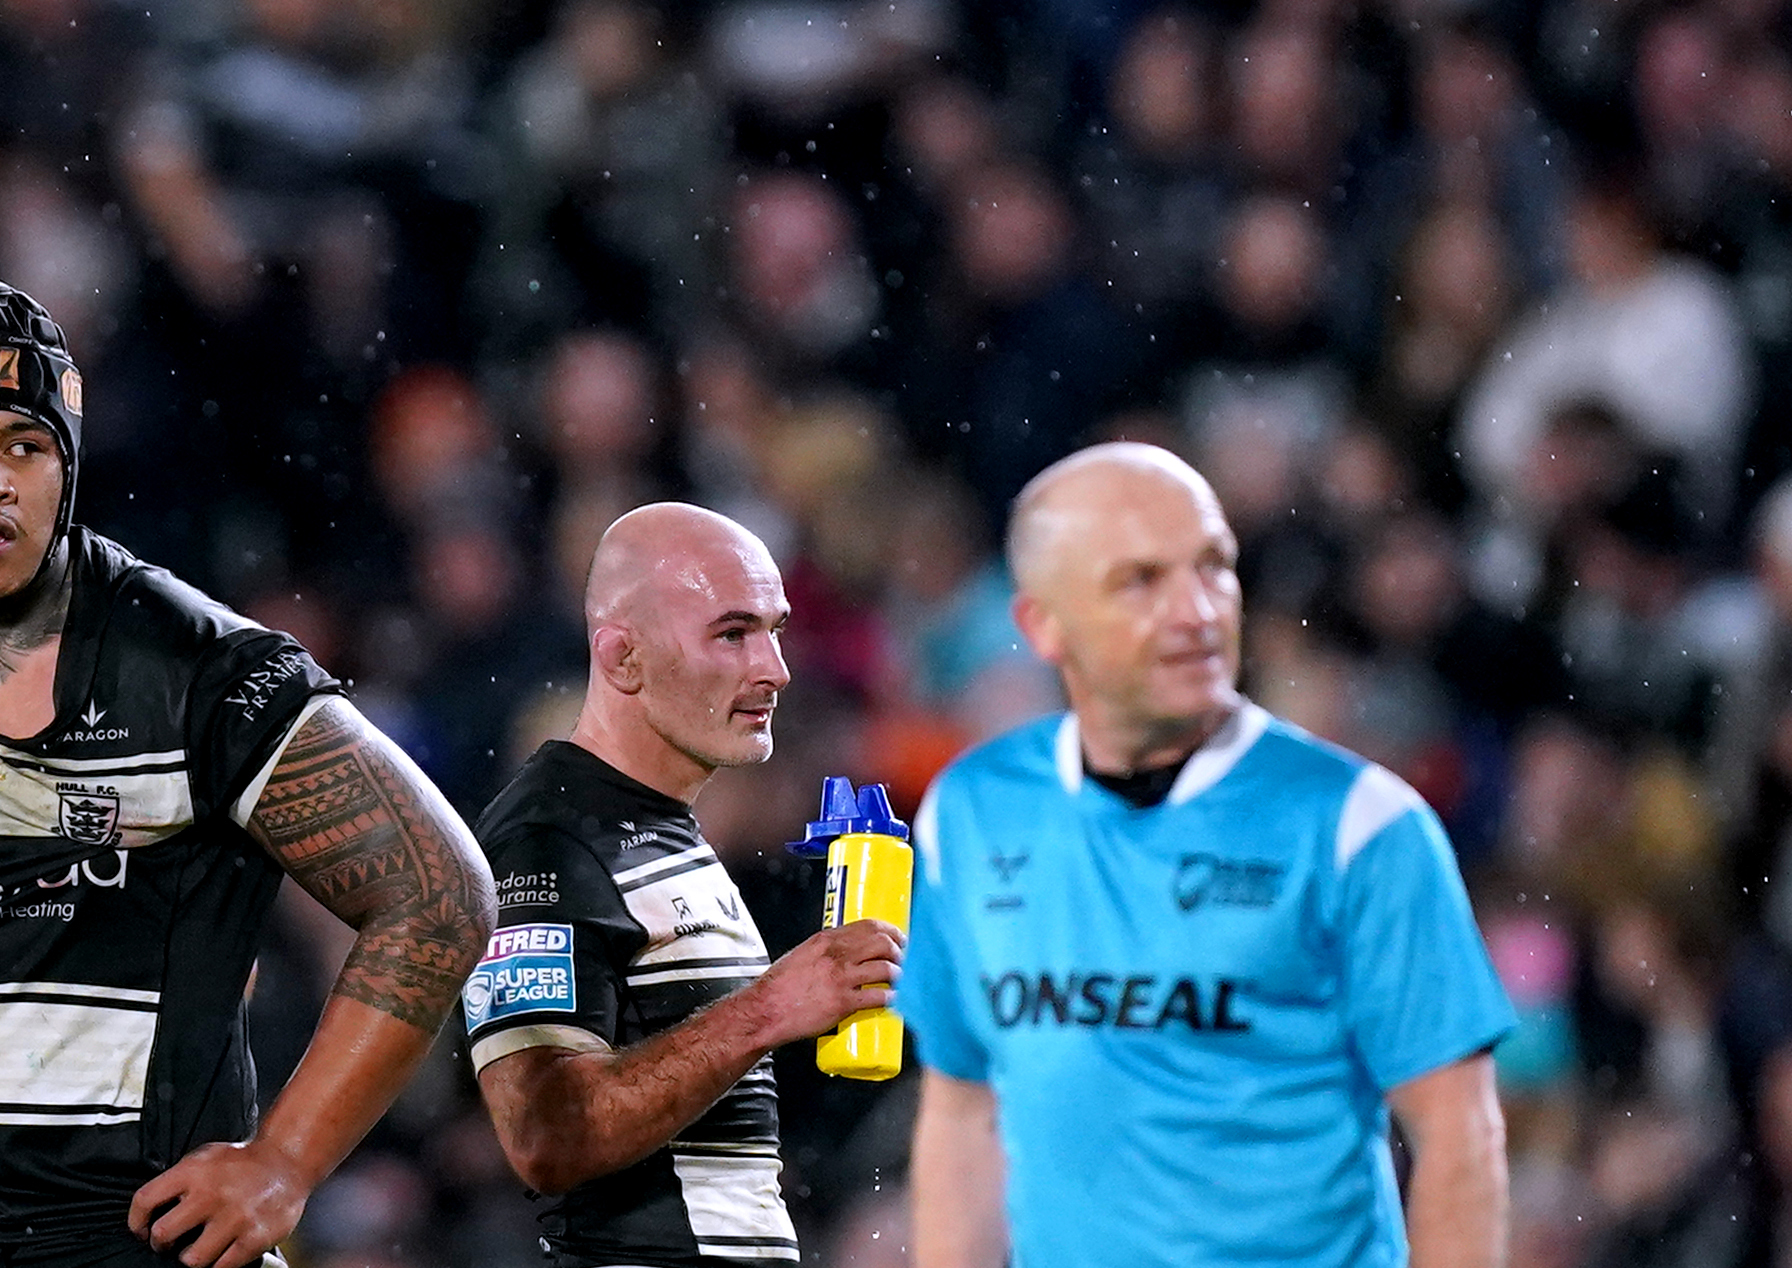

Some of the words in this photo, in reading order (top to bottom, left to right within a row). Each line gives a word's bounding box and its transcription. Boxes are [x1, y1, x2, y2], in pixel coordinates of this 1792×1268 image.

[62, 728, 129, 742] ARAGON
[56, 782, 89, 792] HULL
[96, 785, 119, 796] F.C.
[494, 872, 537, 892] edon
[498, 891, 560, 906] urance
[487, 929, 567, 958] TFRED
[495, 967, 568, 990] SUPER
[495, 985, 568, 1006] LEAGUE
[983, 970, 1254, 1033] ONSEAL
